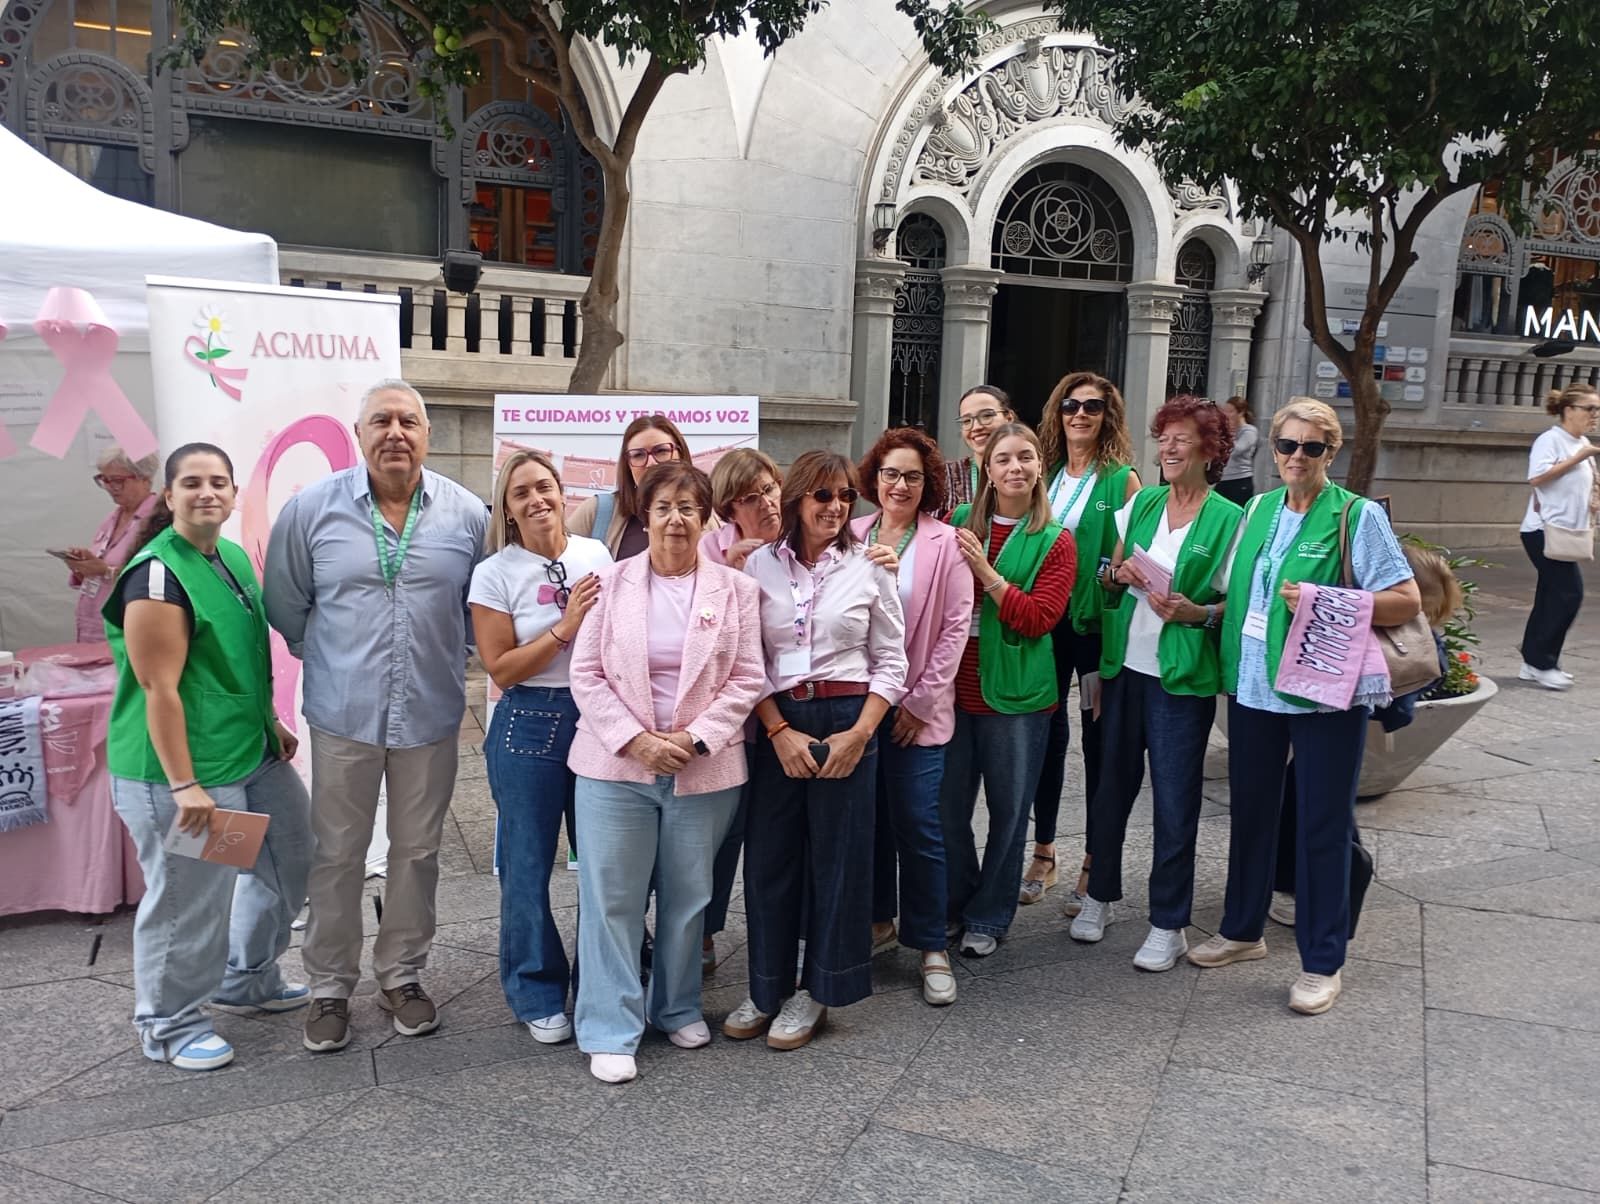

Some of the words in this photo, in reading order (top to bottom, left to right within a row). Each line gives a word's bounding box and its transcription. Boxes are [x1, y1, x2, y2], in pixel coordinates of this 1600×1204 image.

[1524, 305, 1600, 342] MAN
[250, 330, 380, 360] ACMUMA
[501, 409, 521, 422] TE
[525, 409, 611, 423] CUIDAMOS
[615, 410, 627, 422] Y
[716, 410, 749, 423] VOZ
